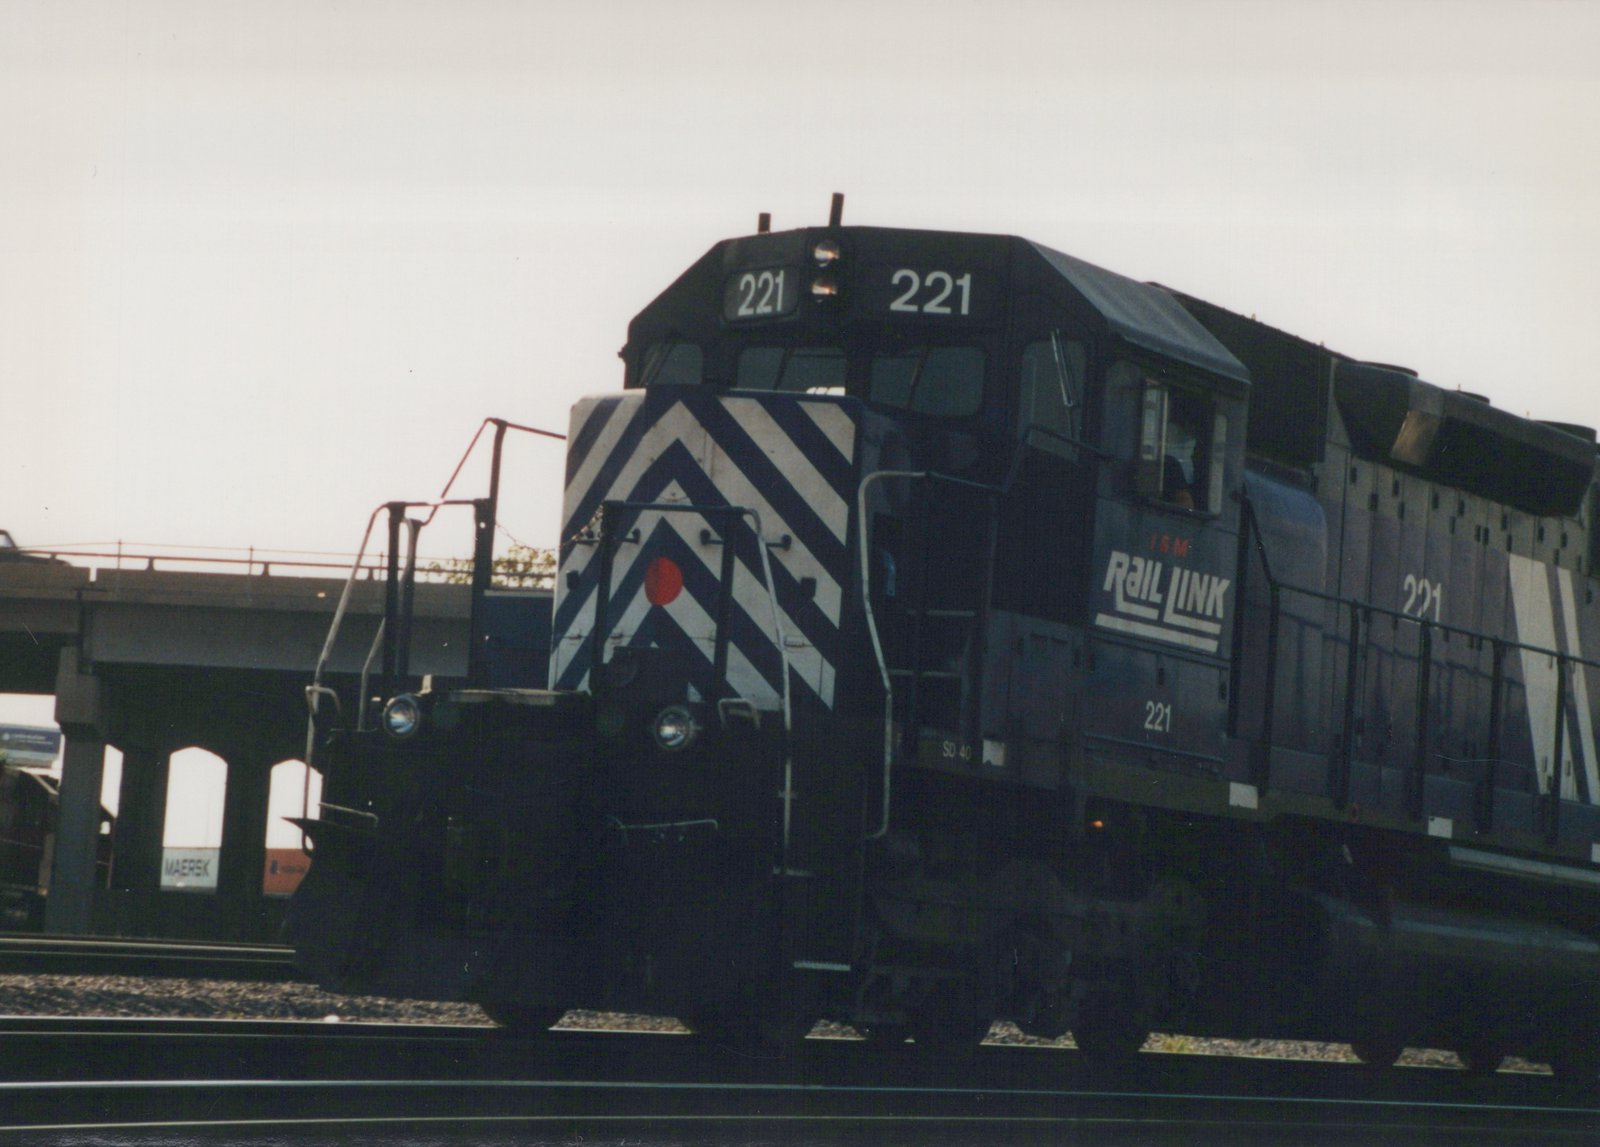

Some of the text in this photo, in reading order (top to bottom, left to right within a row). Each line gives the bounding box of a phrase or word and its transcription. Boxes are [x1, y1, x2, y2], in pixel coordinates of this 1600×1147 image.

[737, 269, 785, 317] 221
[889, 268, 972, 316] 221
[1162, 566, 1231, 635] LINK
[1403, 573, 1442, 630] 221
[1144, 700, 1172, 733] 221
[164, 857, 211, 878] MAERSK
